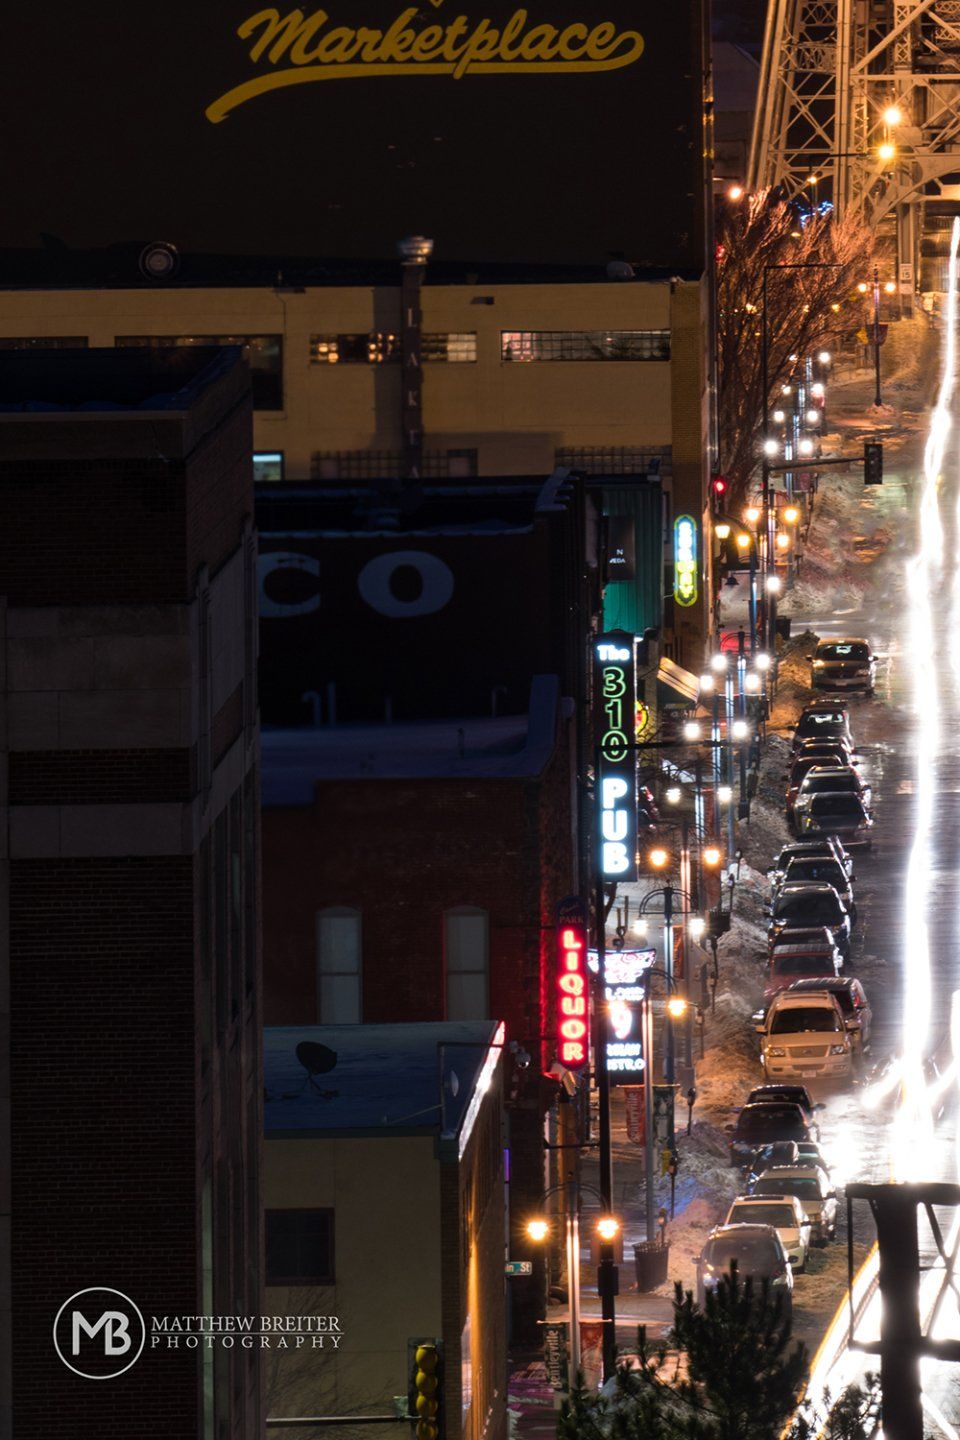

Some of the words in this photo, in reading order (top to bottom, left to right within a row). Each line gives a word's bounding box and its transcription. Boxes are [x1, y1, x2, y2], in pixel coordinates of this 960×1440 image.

[236, 8, 645, 81] Marketplace
[597, 644, 631, 662] The
[602, 665, 628, 763] 310
[602, 777, 630, 875] PUB
[559, 929, 587, 1062] LIQUOR
